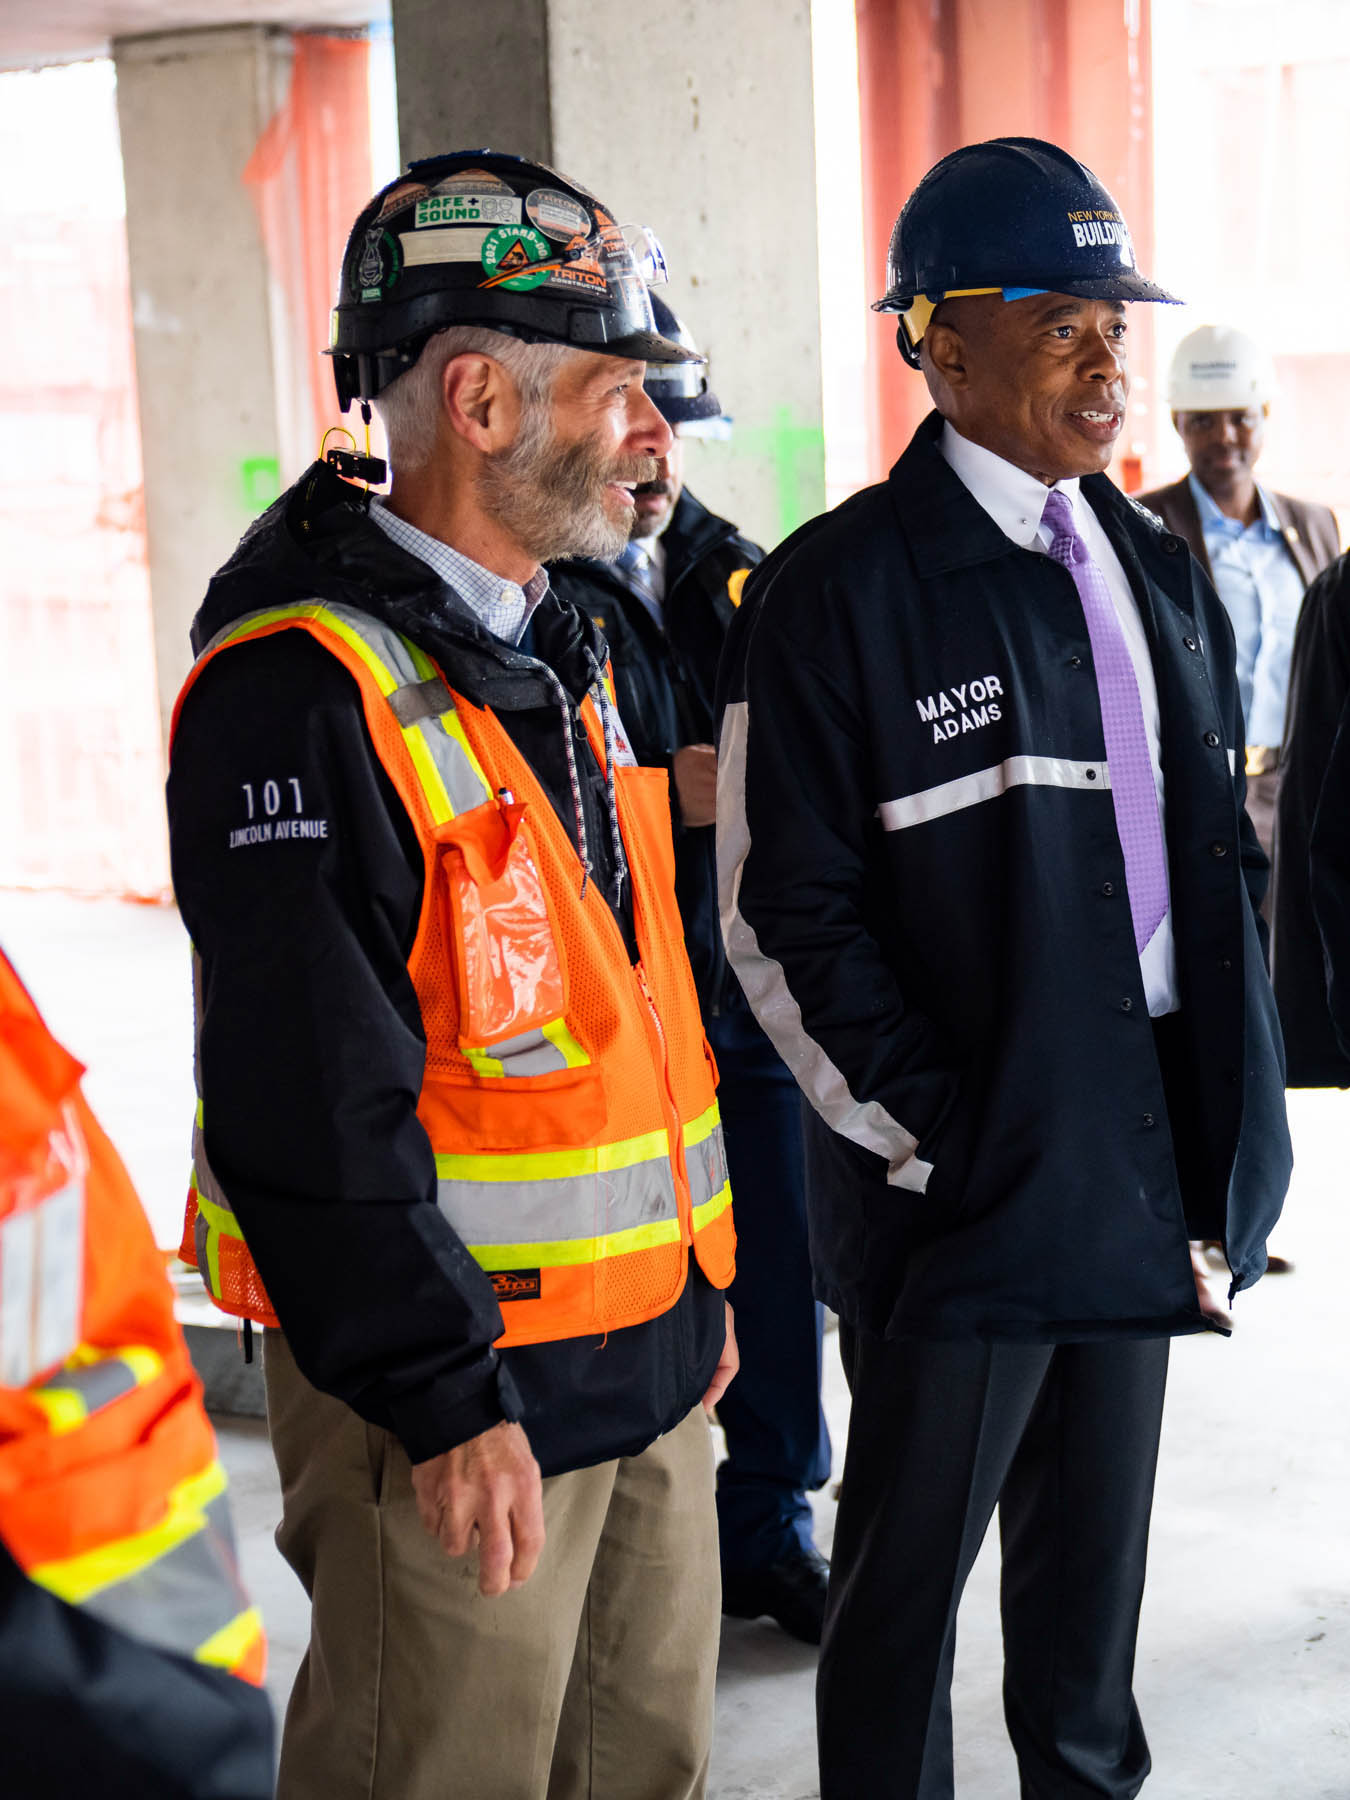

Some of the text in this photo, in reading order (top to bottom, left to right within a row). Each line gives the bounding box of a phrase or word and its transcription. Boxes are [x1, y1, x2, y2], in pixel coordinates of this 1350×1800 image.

[418, 197, 464, 211] SAFE
[418, 208, 480, 224] SOUND
[1067, 211, 1092, 223] NEW
[485, 238, 499, 264] 2021
[499, 227, 549, 260] STAND-DO
[1071, 221, 1128, 248] BUILDIN
[551, 277, 607, 293] CONSTRUCTION
[554, 268, 607, 289] TRITON
[916, 675, 1004, 722] MAYOR
[933, 703, 1002, 744] ADAMS
[229, 820, 328, 849] LINCOLN AVENUE
